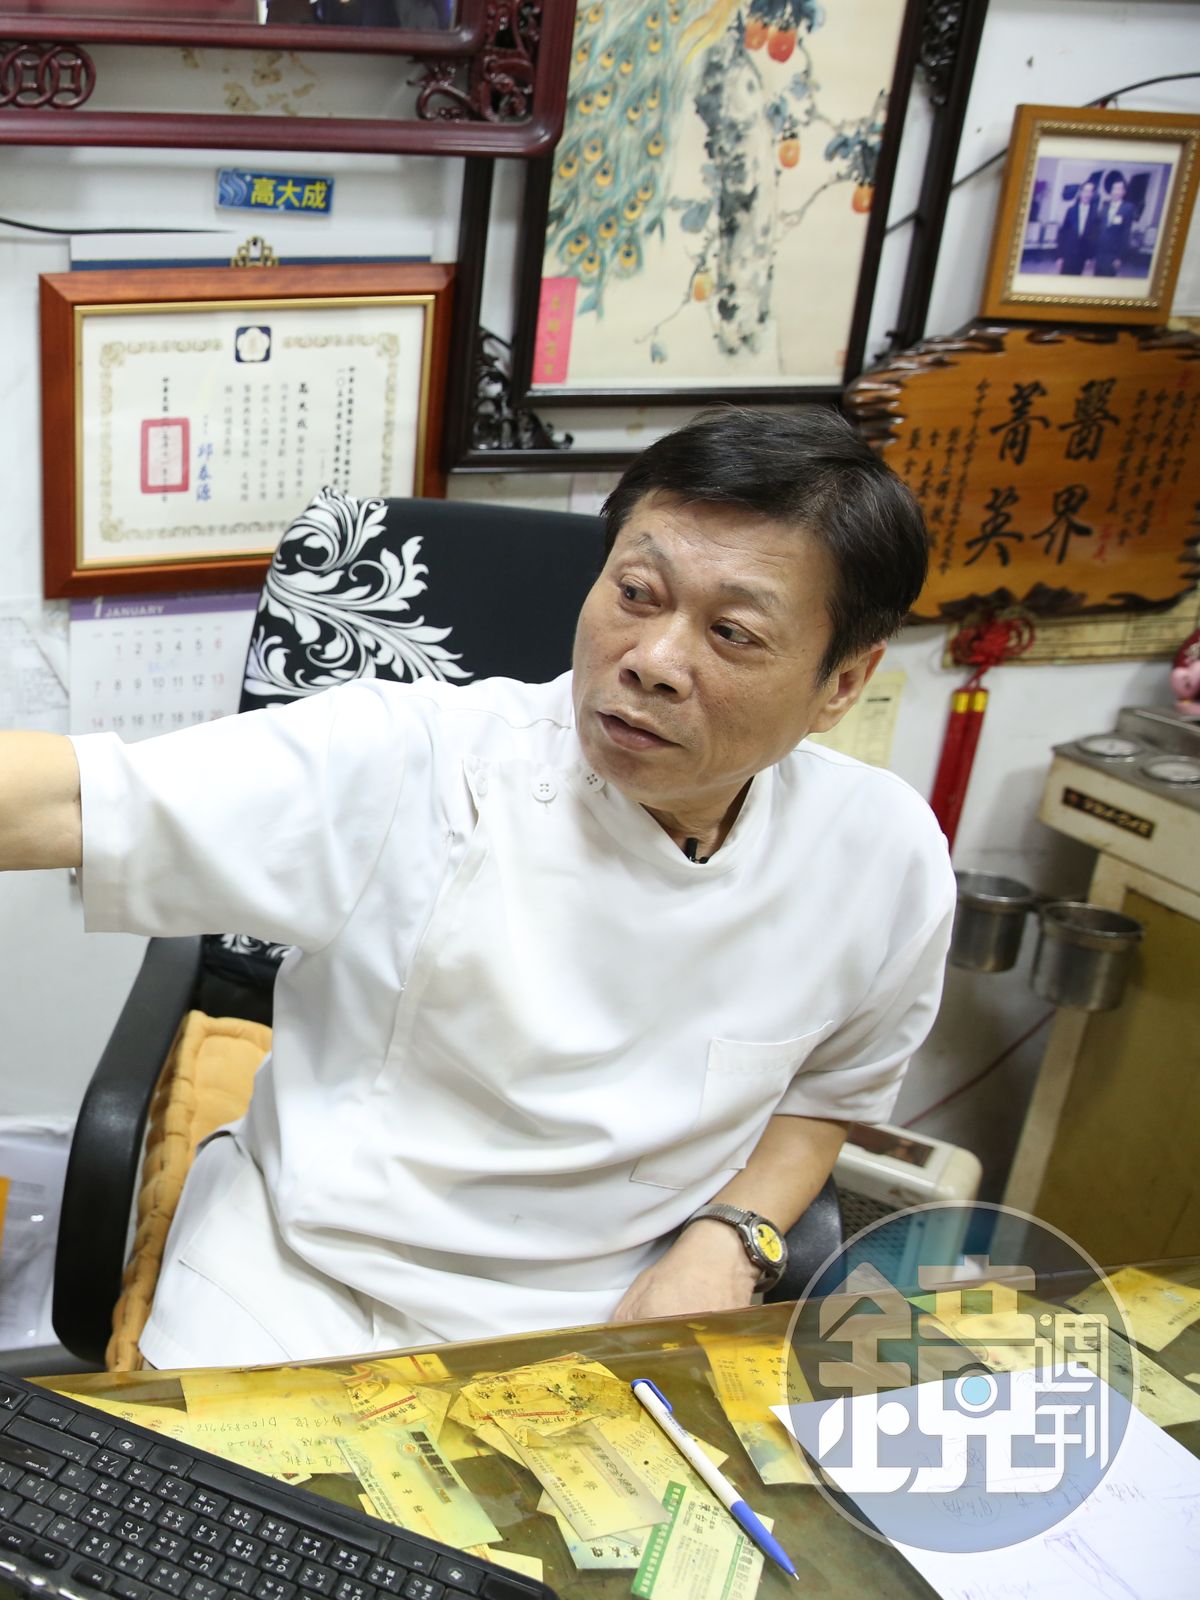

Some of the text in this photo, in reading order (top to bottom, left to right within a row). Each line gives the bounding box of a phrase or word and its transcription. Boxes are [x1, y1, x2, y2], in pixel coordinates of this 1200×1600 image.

[251, 178, 327, 208] 高大成
[105, 605, 164, 618] JANUARY
